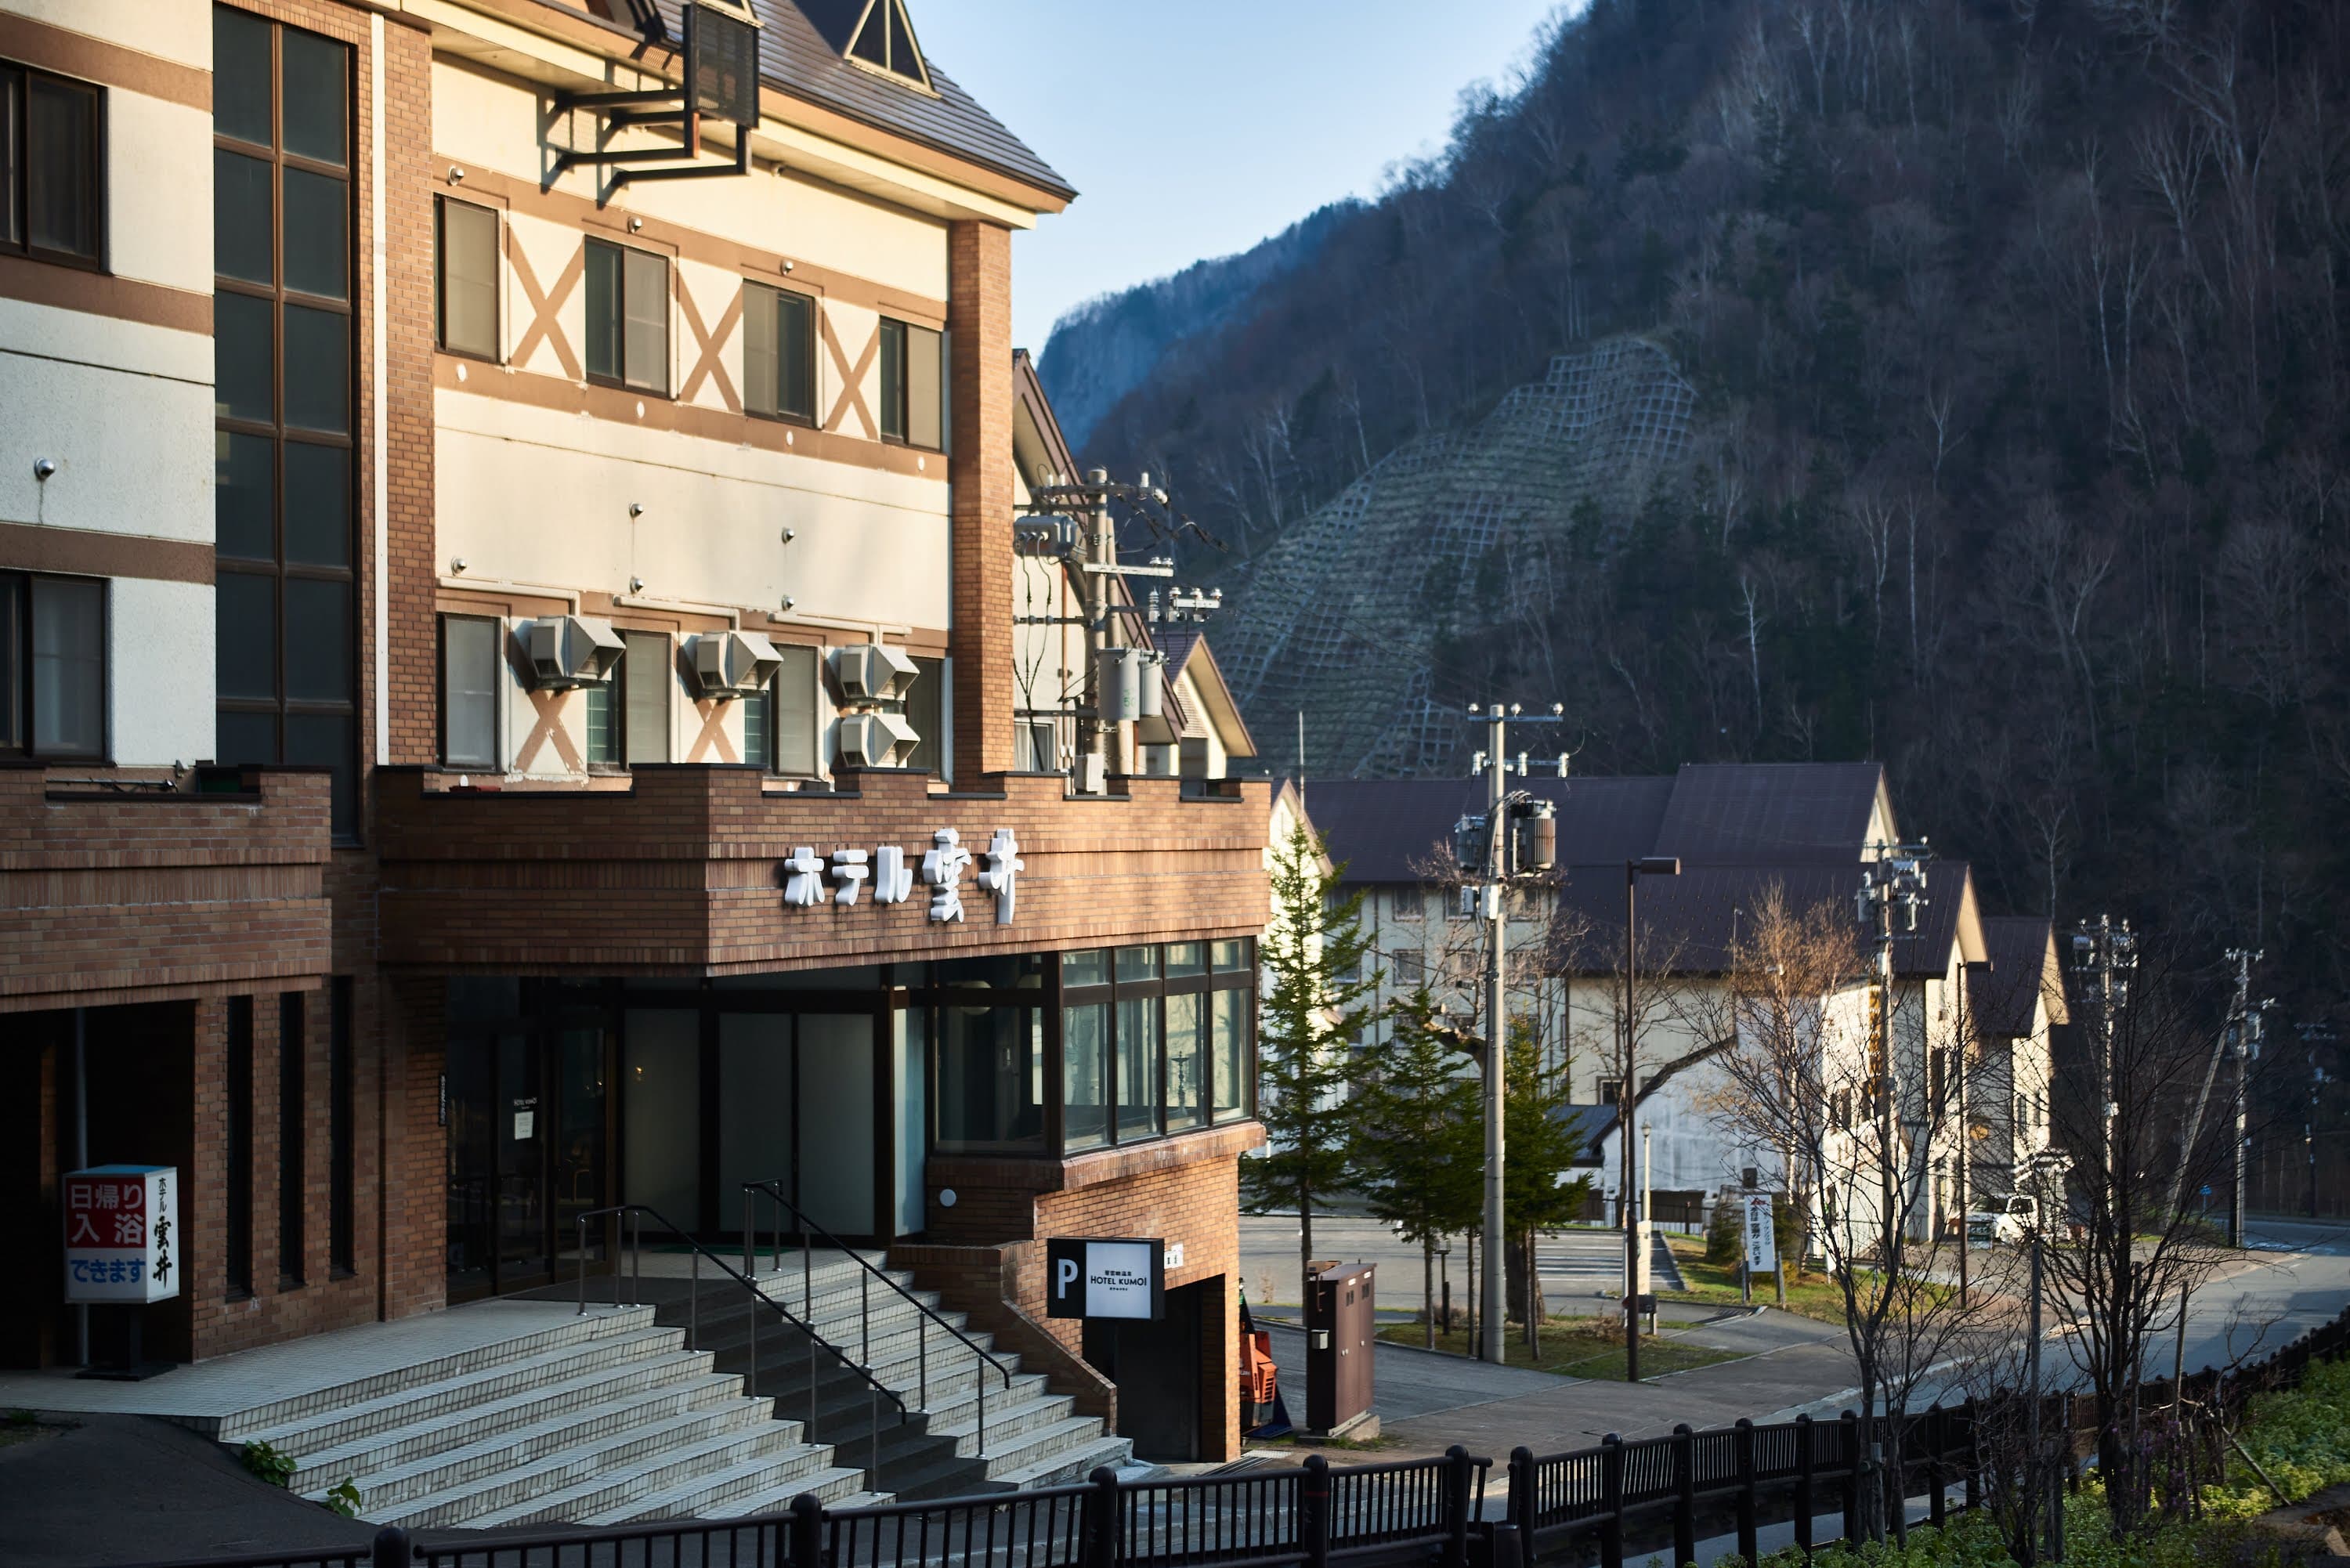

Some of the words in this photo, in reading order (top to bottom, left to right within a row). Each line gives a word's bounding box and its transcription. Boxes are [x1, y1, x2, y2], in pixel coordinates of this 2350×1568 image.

[70, 1184, 143, 1209] 日帰り
[71, 1214, 144, 1245] 入浴
[153, 1177, 172, 1289] ホテル雲井
[70, 1258, 146, 1284] できます
[1058, 1259, 1079, 1299] P
[1090, 1275, 1116, 1285] HOTEL
[1119, 1277, 1147, 1286] KUMOI
